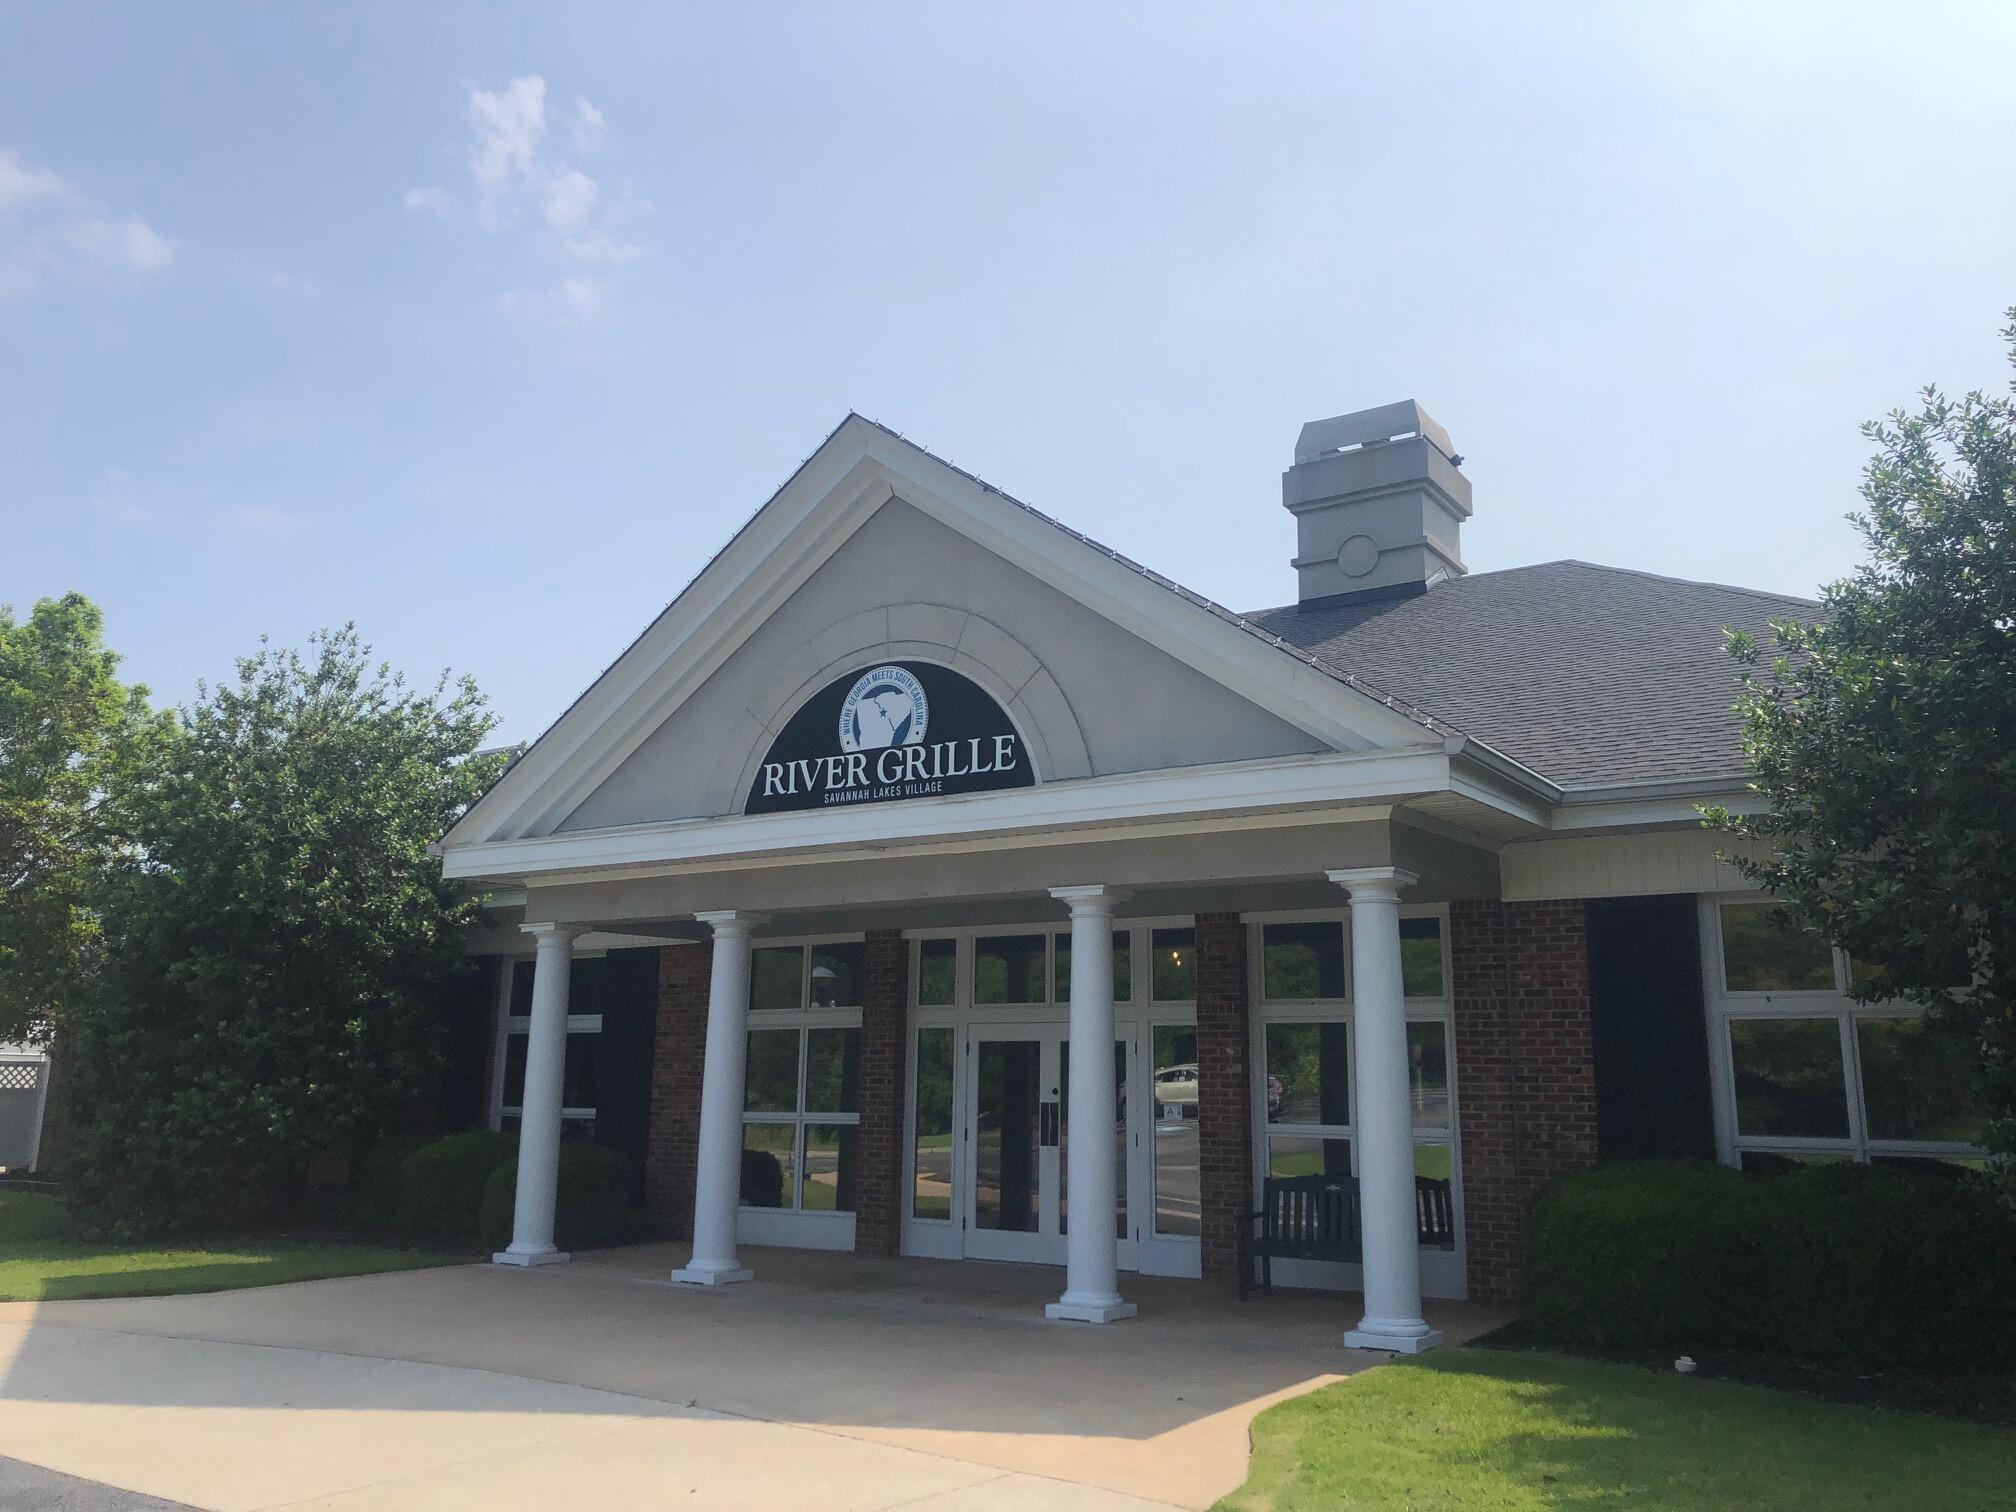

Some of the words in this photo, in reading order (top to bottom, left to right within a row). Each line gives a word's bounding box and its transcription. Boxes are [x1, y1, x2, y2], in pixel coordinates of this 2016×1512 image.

[843, 706, 853, 736] WHERE
[848, 678, 872, 707] GEORGIA
[871, 670, 894, 683] MEETS
[894, 671, 914, 690] SOUTH
[910, 687, 924, 726] CAROLINA
[763, 753, 871, 796] RIVER
[877, 734, 1017, 784] GRILLE
[824, 788, 870, 804] SAVANNAH
[873, 785, 901, 798] LAKES
[905, 780, 943, 795] VILLAGE
